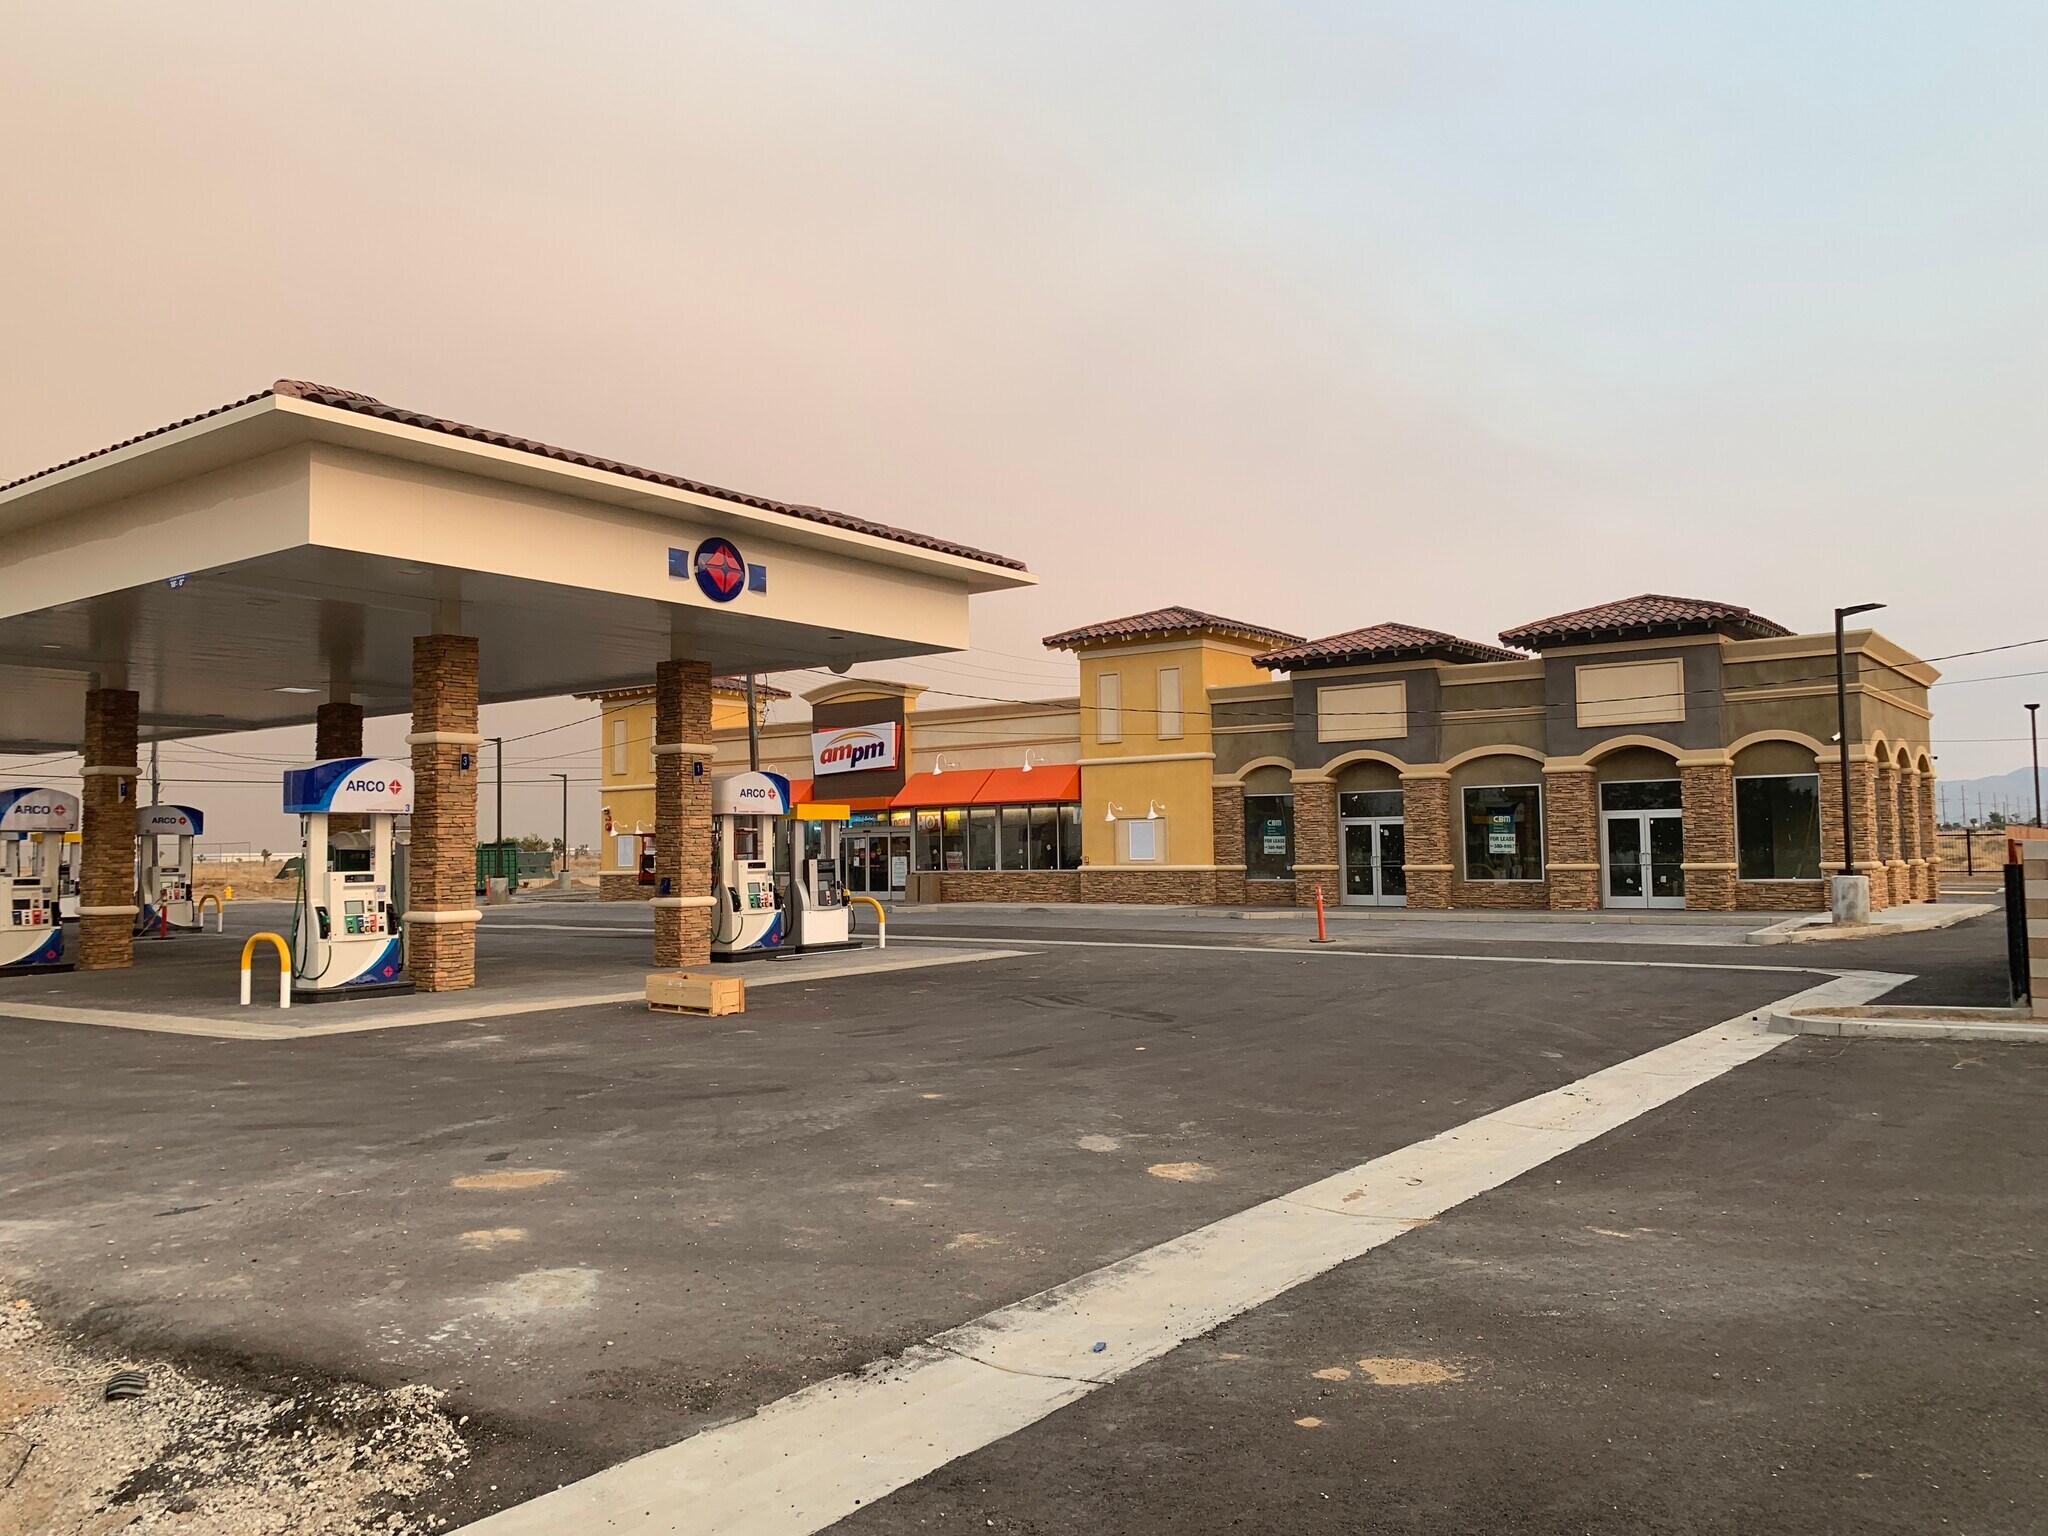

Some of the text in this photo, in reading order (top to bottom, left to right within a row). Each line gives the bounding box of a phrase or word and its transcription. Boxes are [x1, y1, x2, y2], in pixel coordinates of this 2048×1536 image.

[820, 741, 885, 768] ampm
[346, 780, 385, 792] ARCO
[740, 788, 766, 798] ARCO
[14, 805, 51, 815] ARCO
[405, 804, 410, 812] 3
